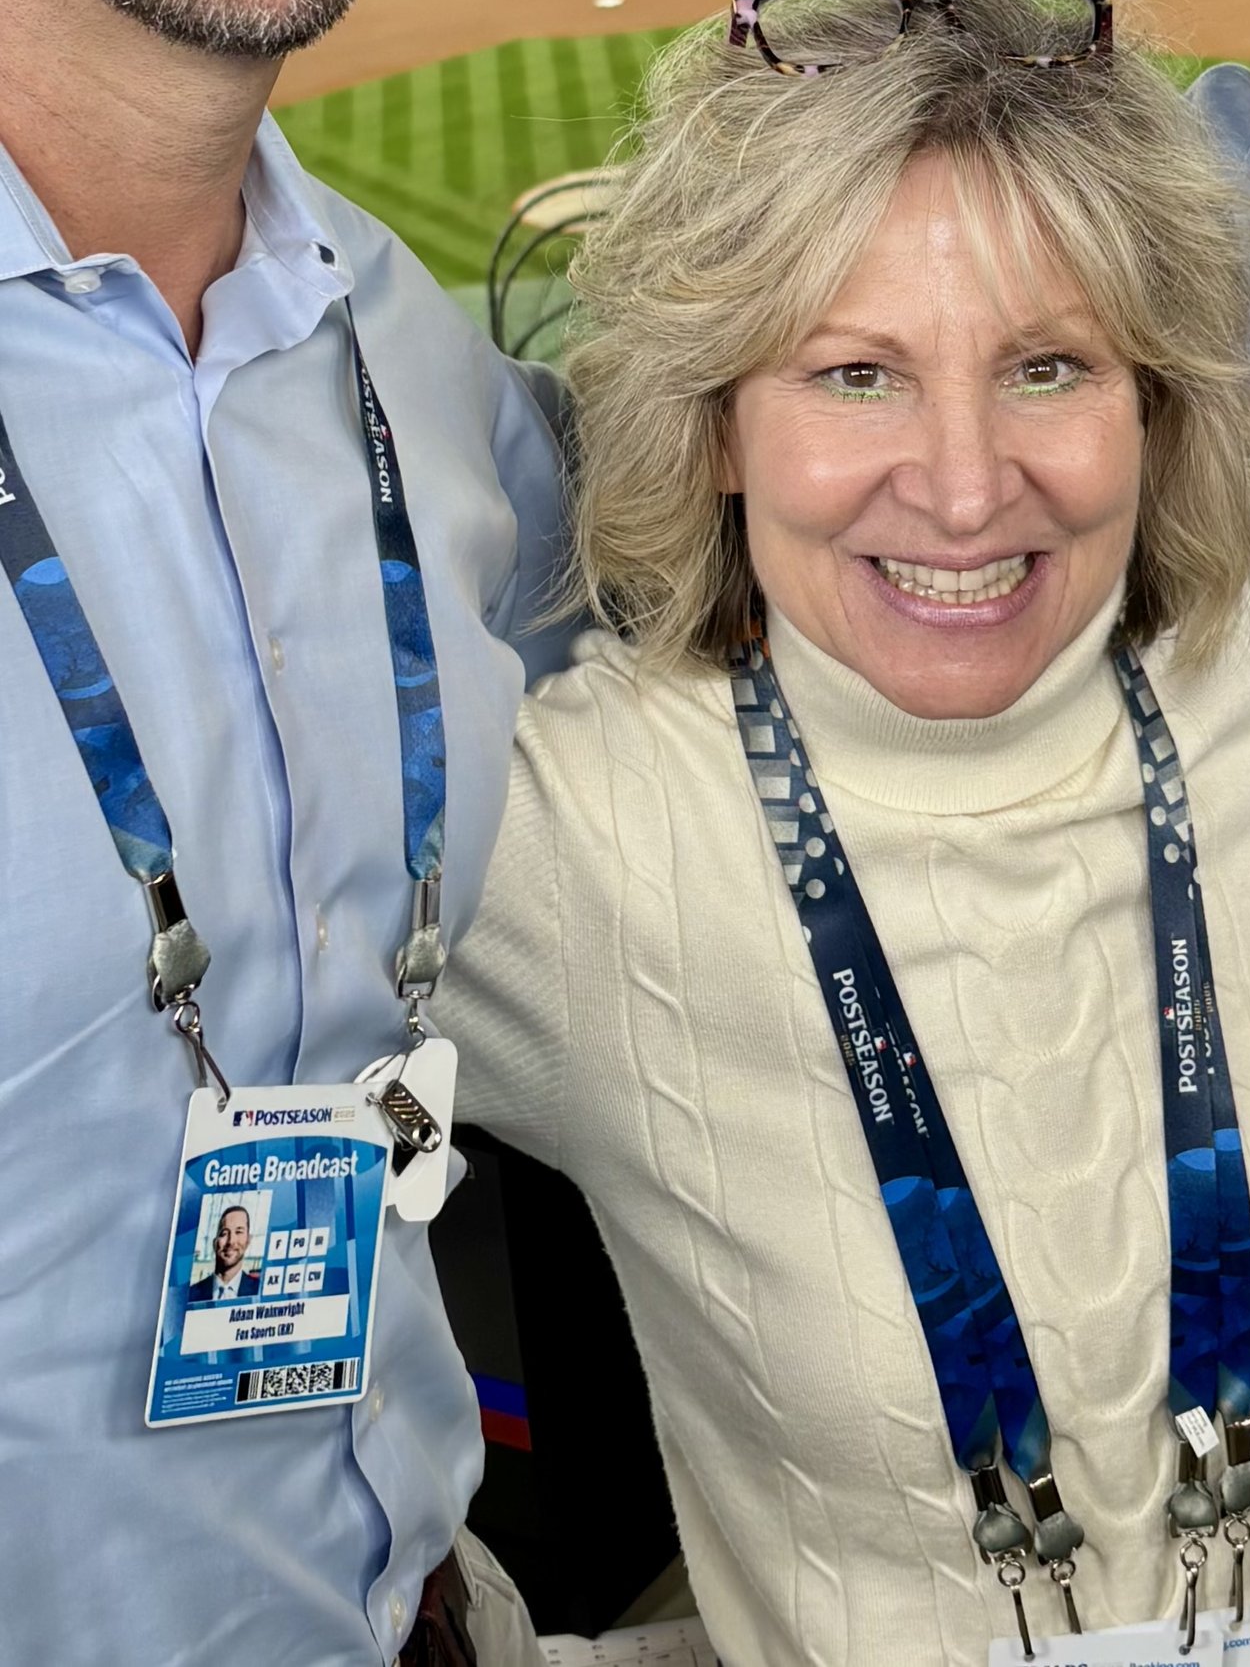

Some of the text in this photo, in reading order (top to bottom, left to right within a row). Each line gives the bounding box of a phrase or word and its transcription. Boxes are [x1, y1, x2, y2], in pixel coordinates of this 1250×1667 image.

[360, 351, 393, 504] OSTSEASON
[1171, 938, 1198, 1093] POSTSEASON
[832, 968, 893, 1124] POSTSEASON
[255, 1107, 333, 1126] POSTSEASON
[204, 1150, 359, 1187] Game Broadcast
[275, 1238, 282, 1250] F
[267, 1275, 279, 1285] AX
[229, 1308, 254, 1323] Adam
[235, 1328, 249, 1341] Fox
[250, 1326, 276, 1340] Sports
